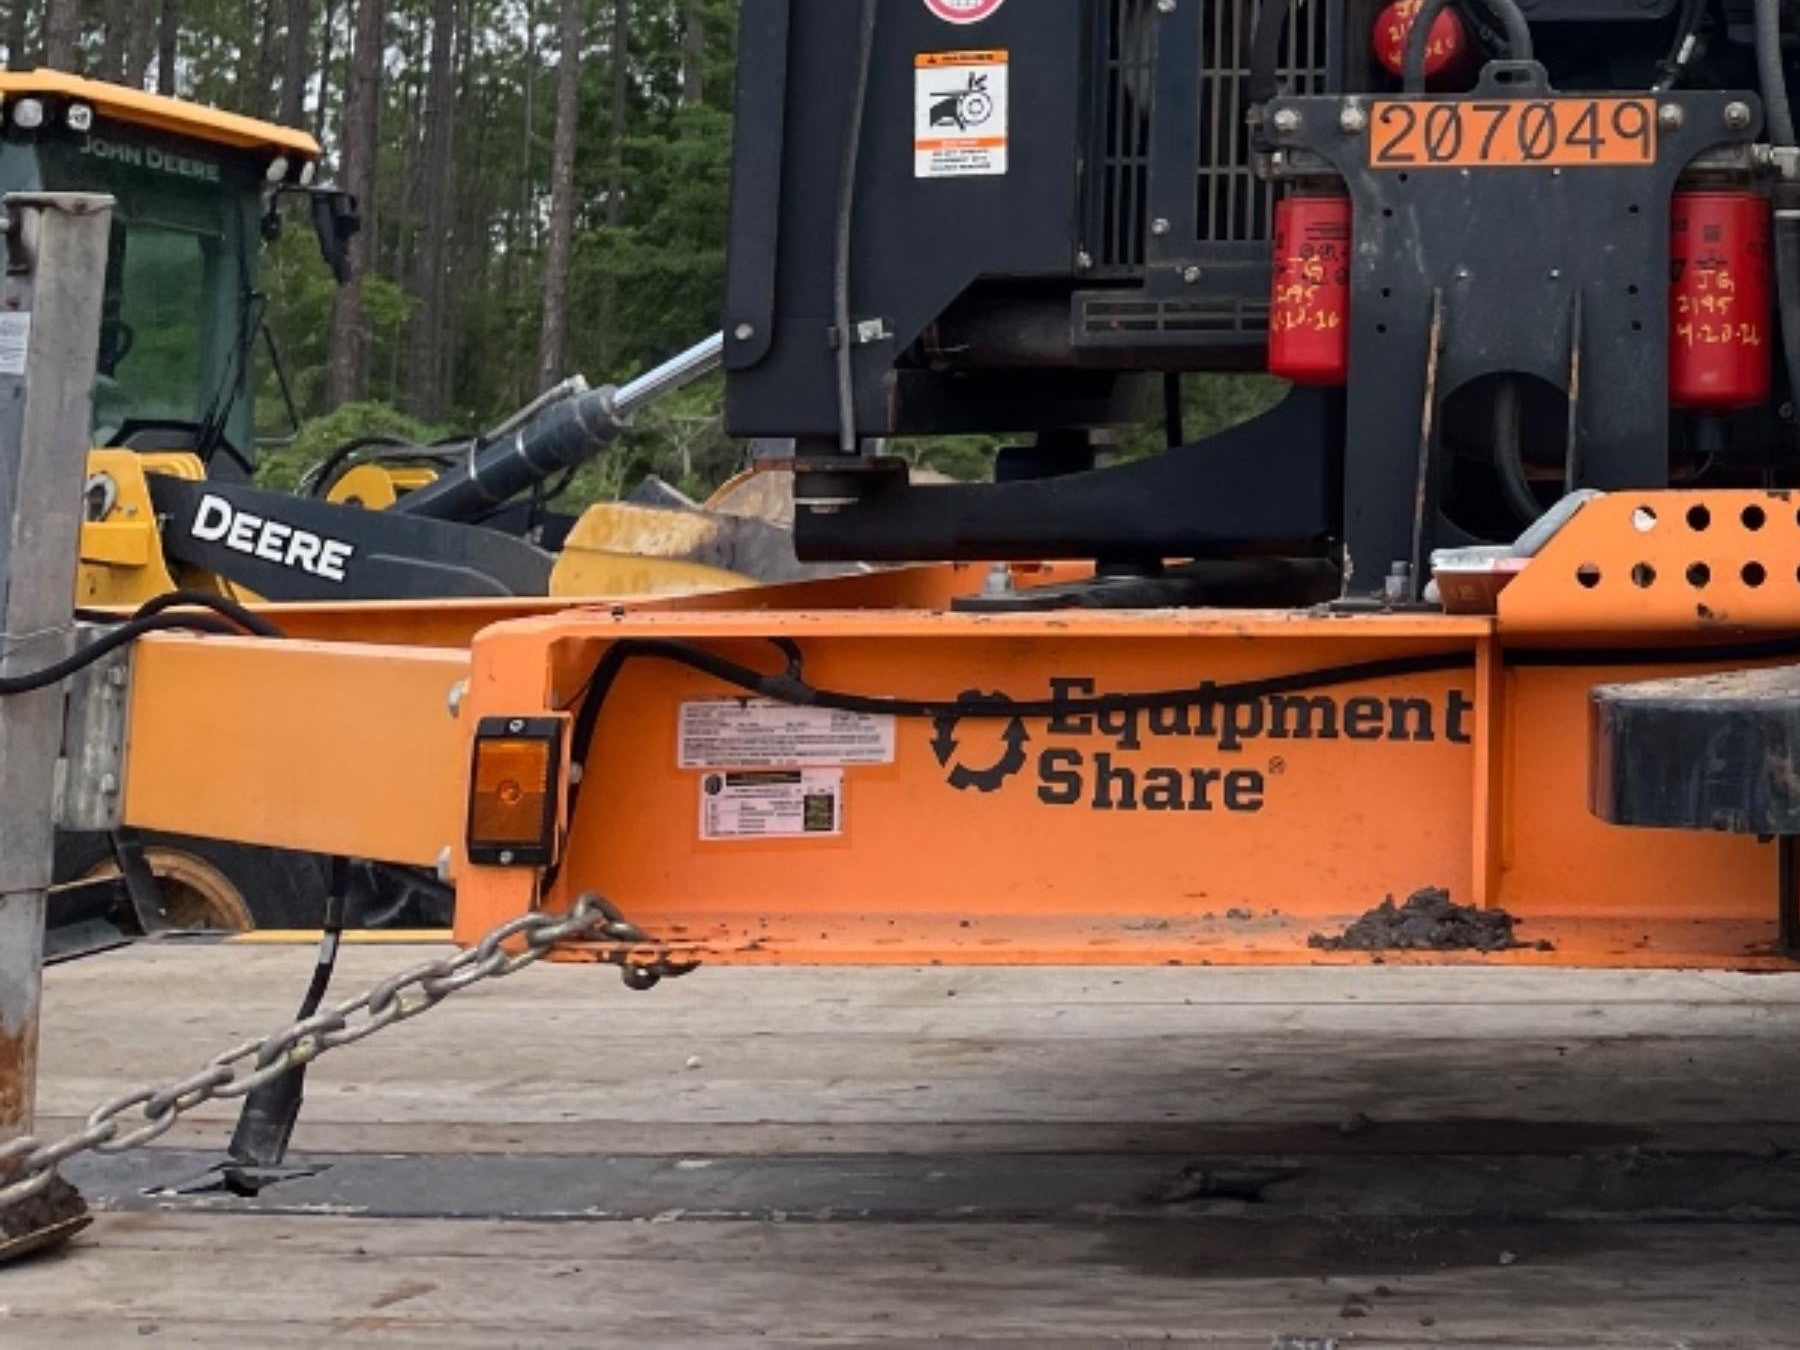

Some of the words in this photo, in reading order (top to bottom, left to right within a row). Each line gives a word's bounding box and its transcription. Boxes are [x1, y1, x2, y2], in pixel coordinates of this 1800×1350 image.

[80, 134, 142, 165] JOHN
[147, 146, 220, 182] DEERE
[1376, 100, 1650, 162] 207049
[191, 494, 354, 582] DEERE
[1046, 677, 1473, 751] Equipment
[1037, 747, 1264, 812] Share
